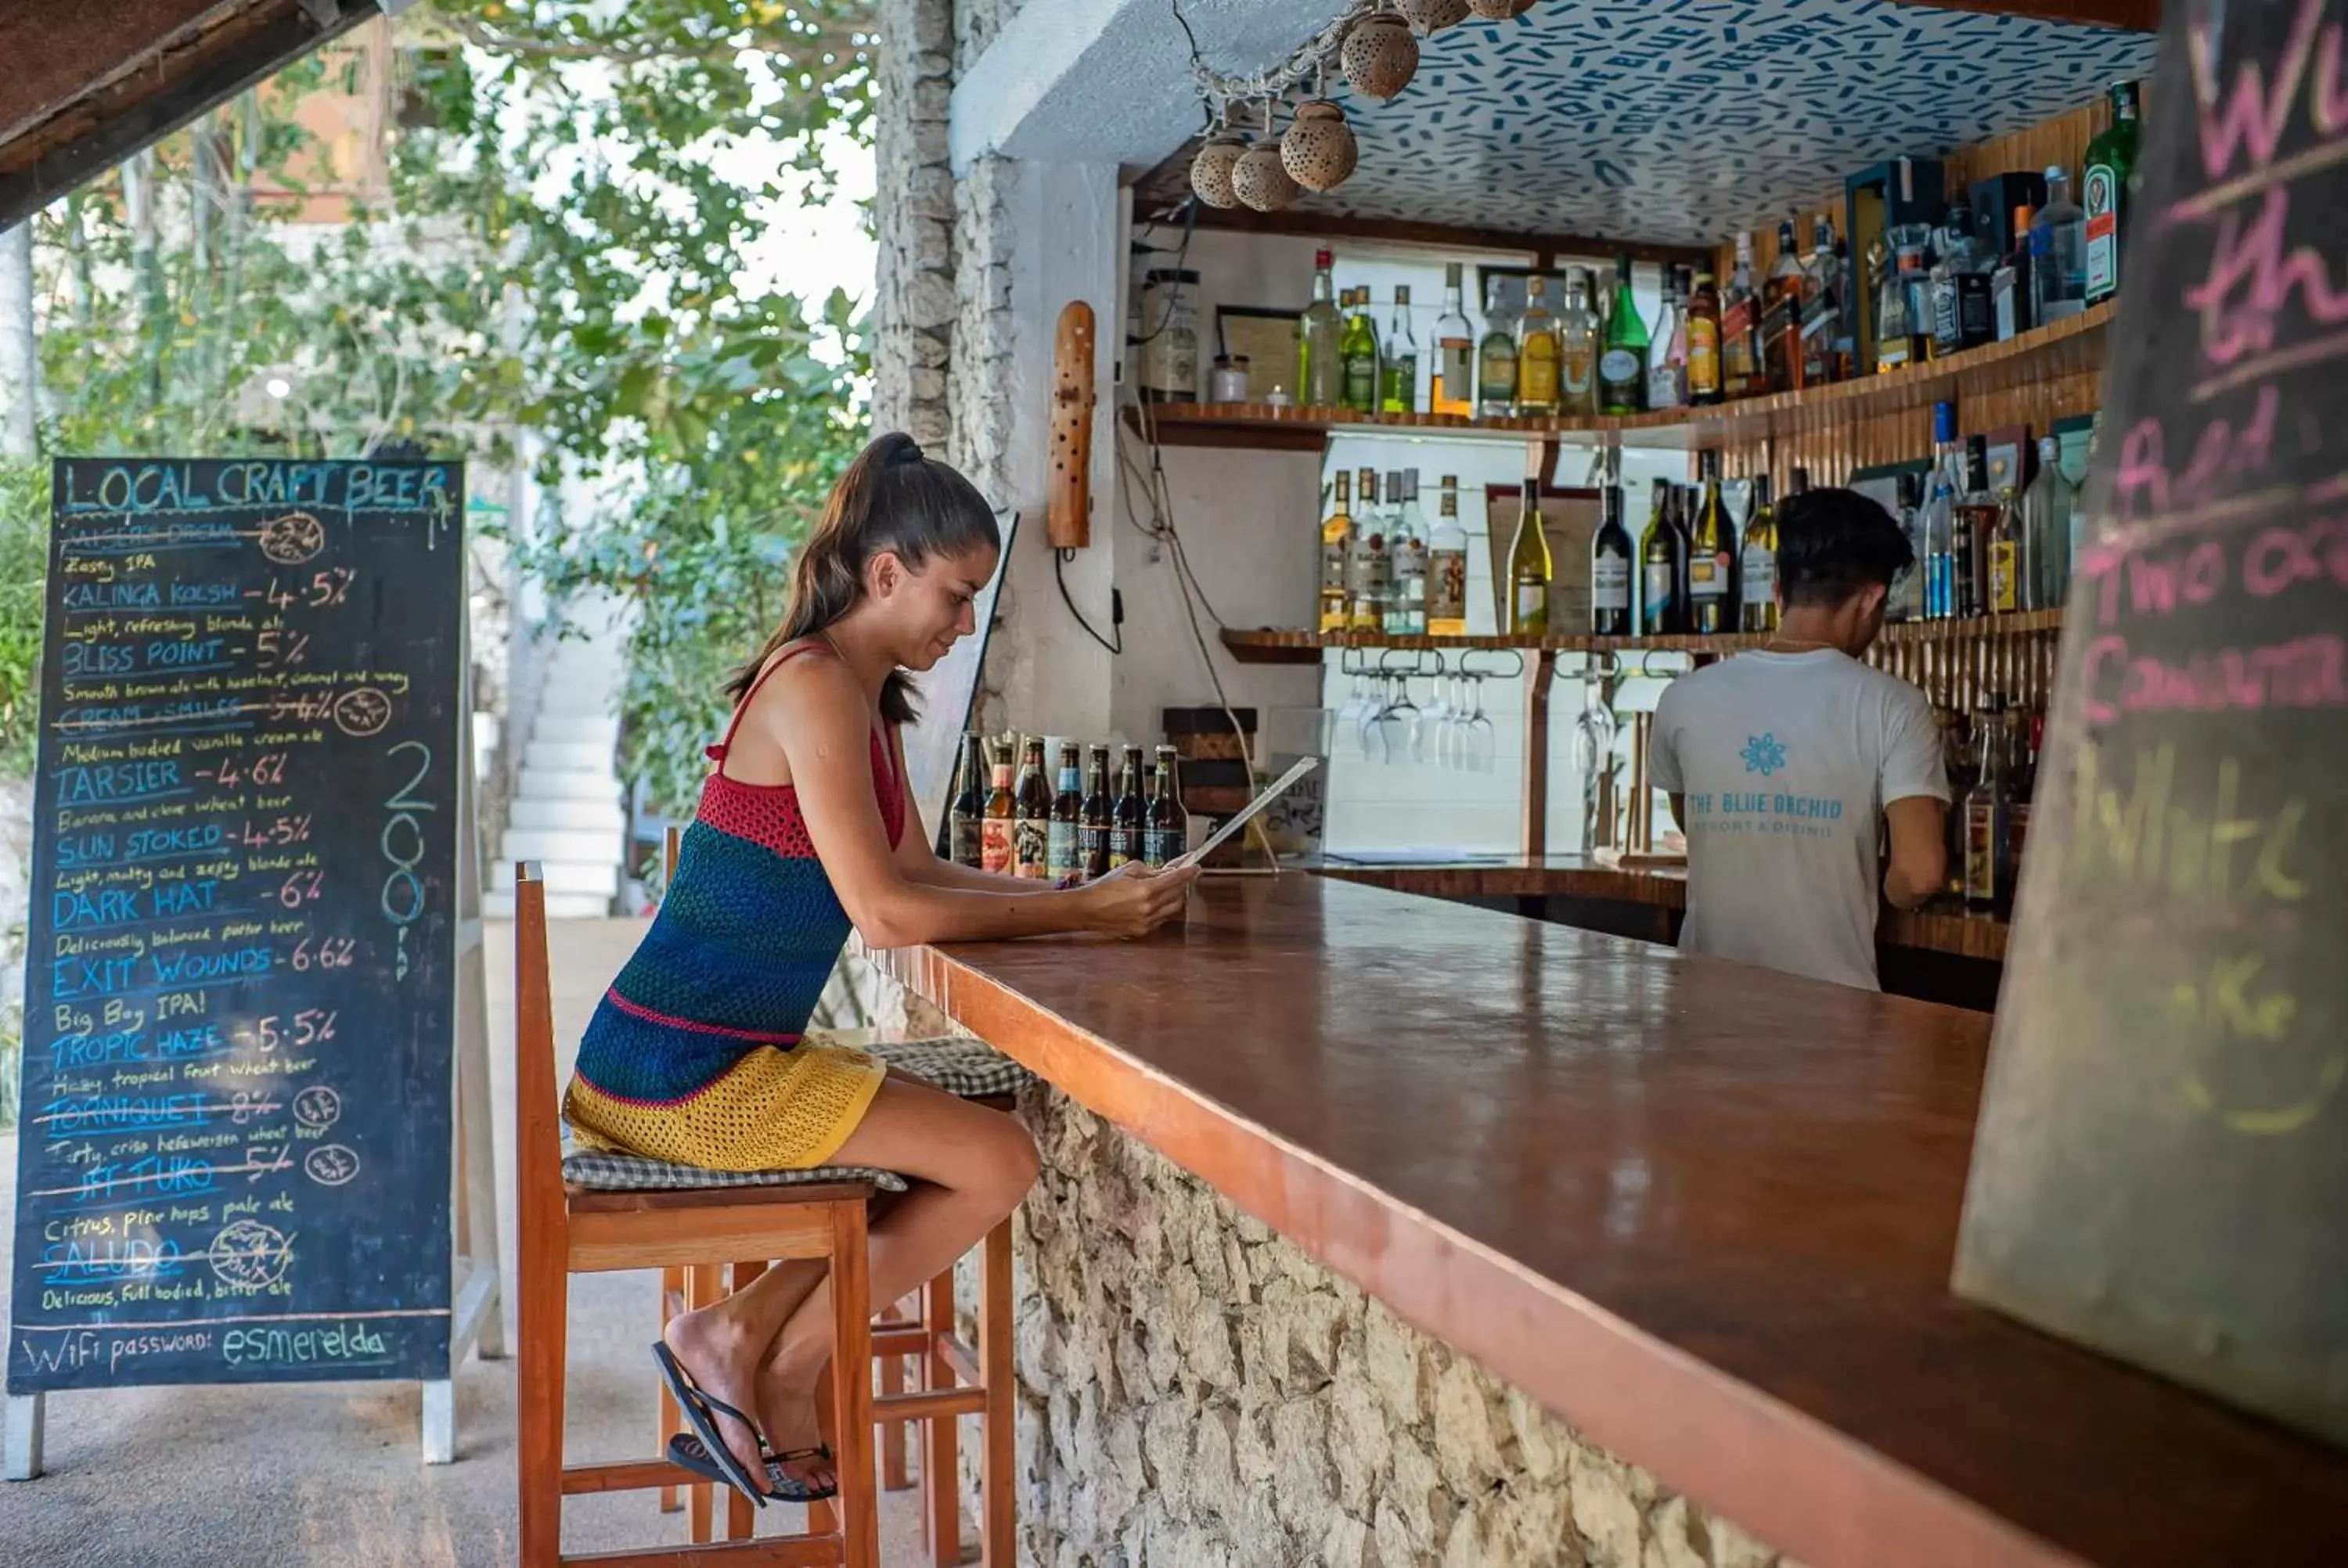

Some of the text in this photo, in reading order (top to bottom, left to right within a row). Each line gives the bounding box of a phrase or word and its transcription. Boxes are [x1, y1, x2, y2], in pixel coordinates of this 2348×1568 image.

[64, 460, 457, 514] LOCAL CRAFT BEER
[124, 553, 156, 572] IPA
[62, 584, 160, 607] KALINGA
[63, 641, 133, 675] BLISS
[147, 638, 225, 665] POINT
[49, 760, 180, 801] TARSIER
[1689, 791, 1843, 820] THE BLUE ORCHID
[56, 833, 116, 866] SUN
[52, 888, 139, 930] DARK
[153, 878, 223, 917] HAT
[52, 955, 138, 999] EXIT
[152, 945, 272, 984] WOUNDS
[55, 1003, 94, 1036] Big
[49, 1028, 149, 1070] TROPIC
[156, 1023, 223, 1056] HAZE
[111, 1064, 176, 1091] tropical
[221, 1322, 387, 1365] esmerelda
